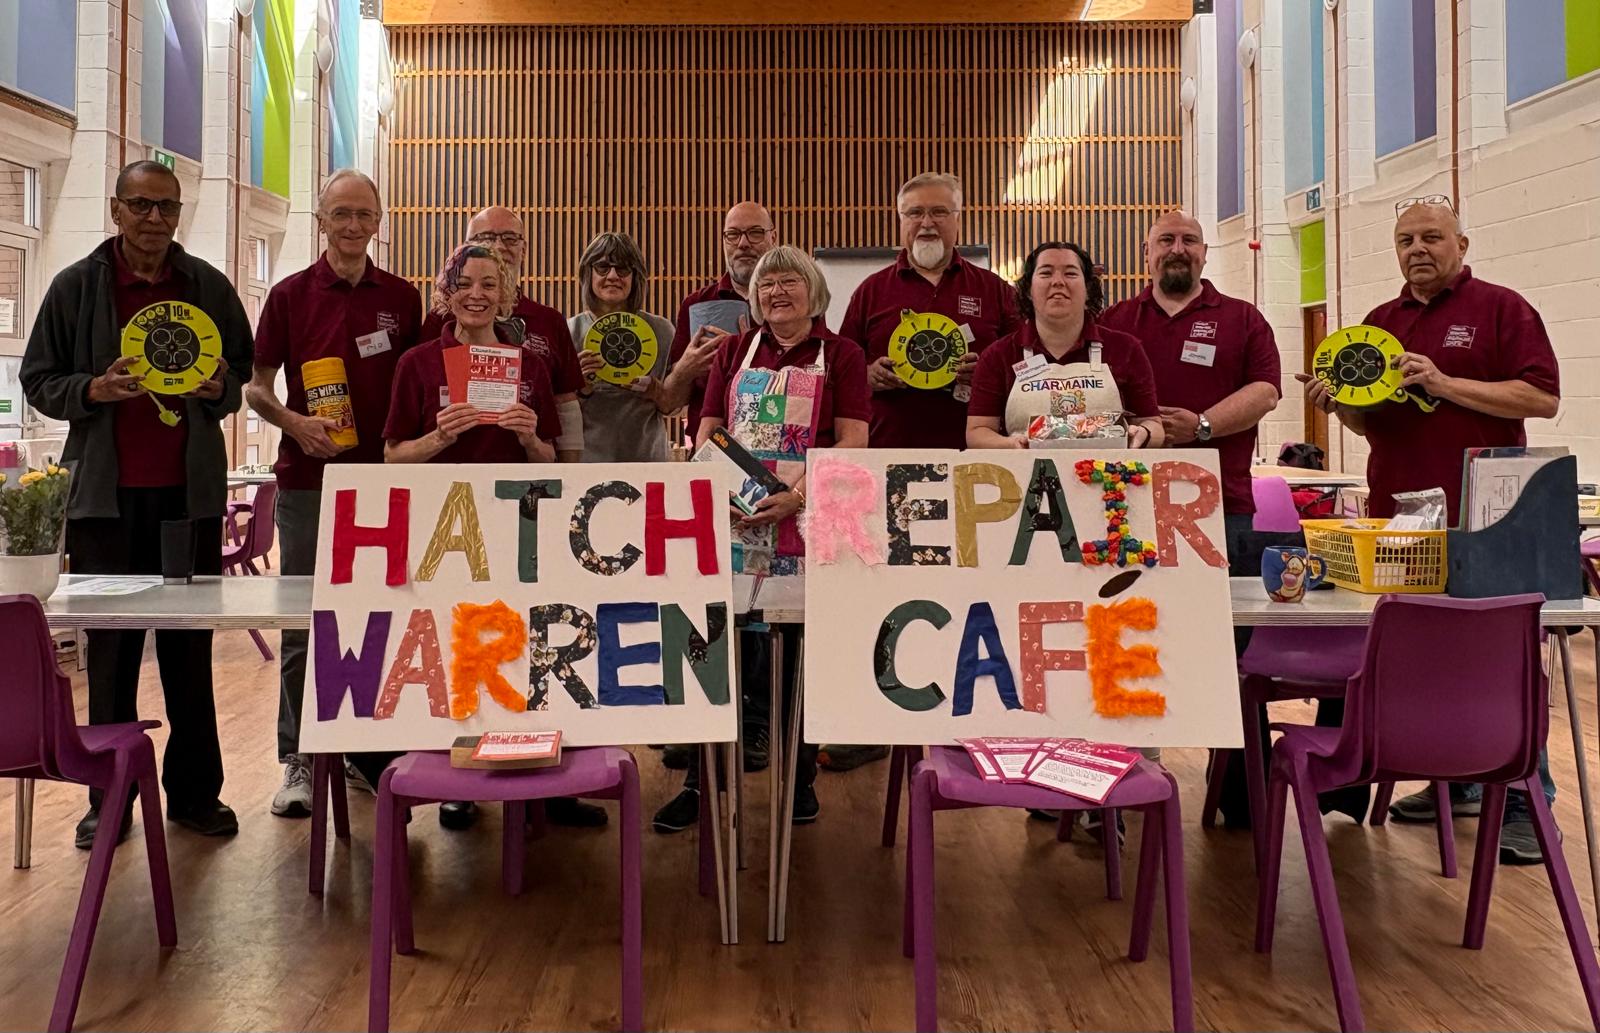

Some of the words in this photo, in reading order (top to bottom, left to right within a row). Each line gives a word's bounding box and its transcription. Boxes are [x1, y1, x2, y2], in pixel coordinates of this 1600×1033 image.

[1021, 379, 1105, 393] CHARMAINE
[330, 479, 719, 586] HATCH
[811, 456, 1230, 568] REPAIR
[313, 599, 730, 721] WARREN
[873, 570, 1167, 718] CAFÉ
